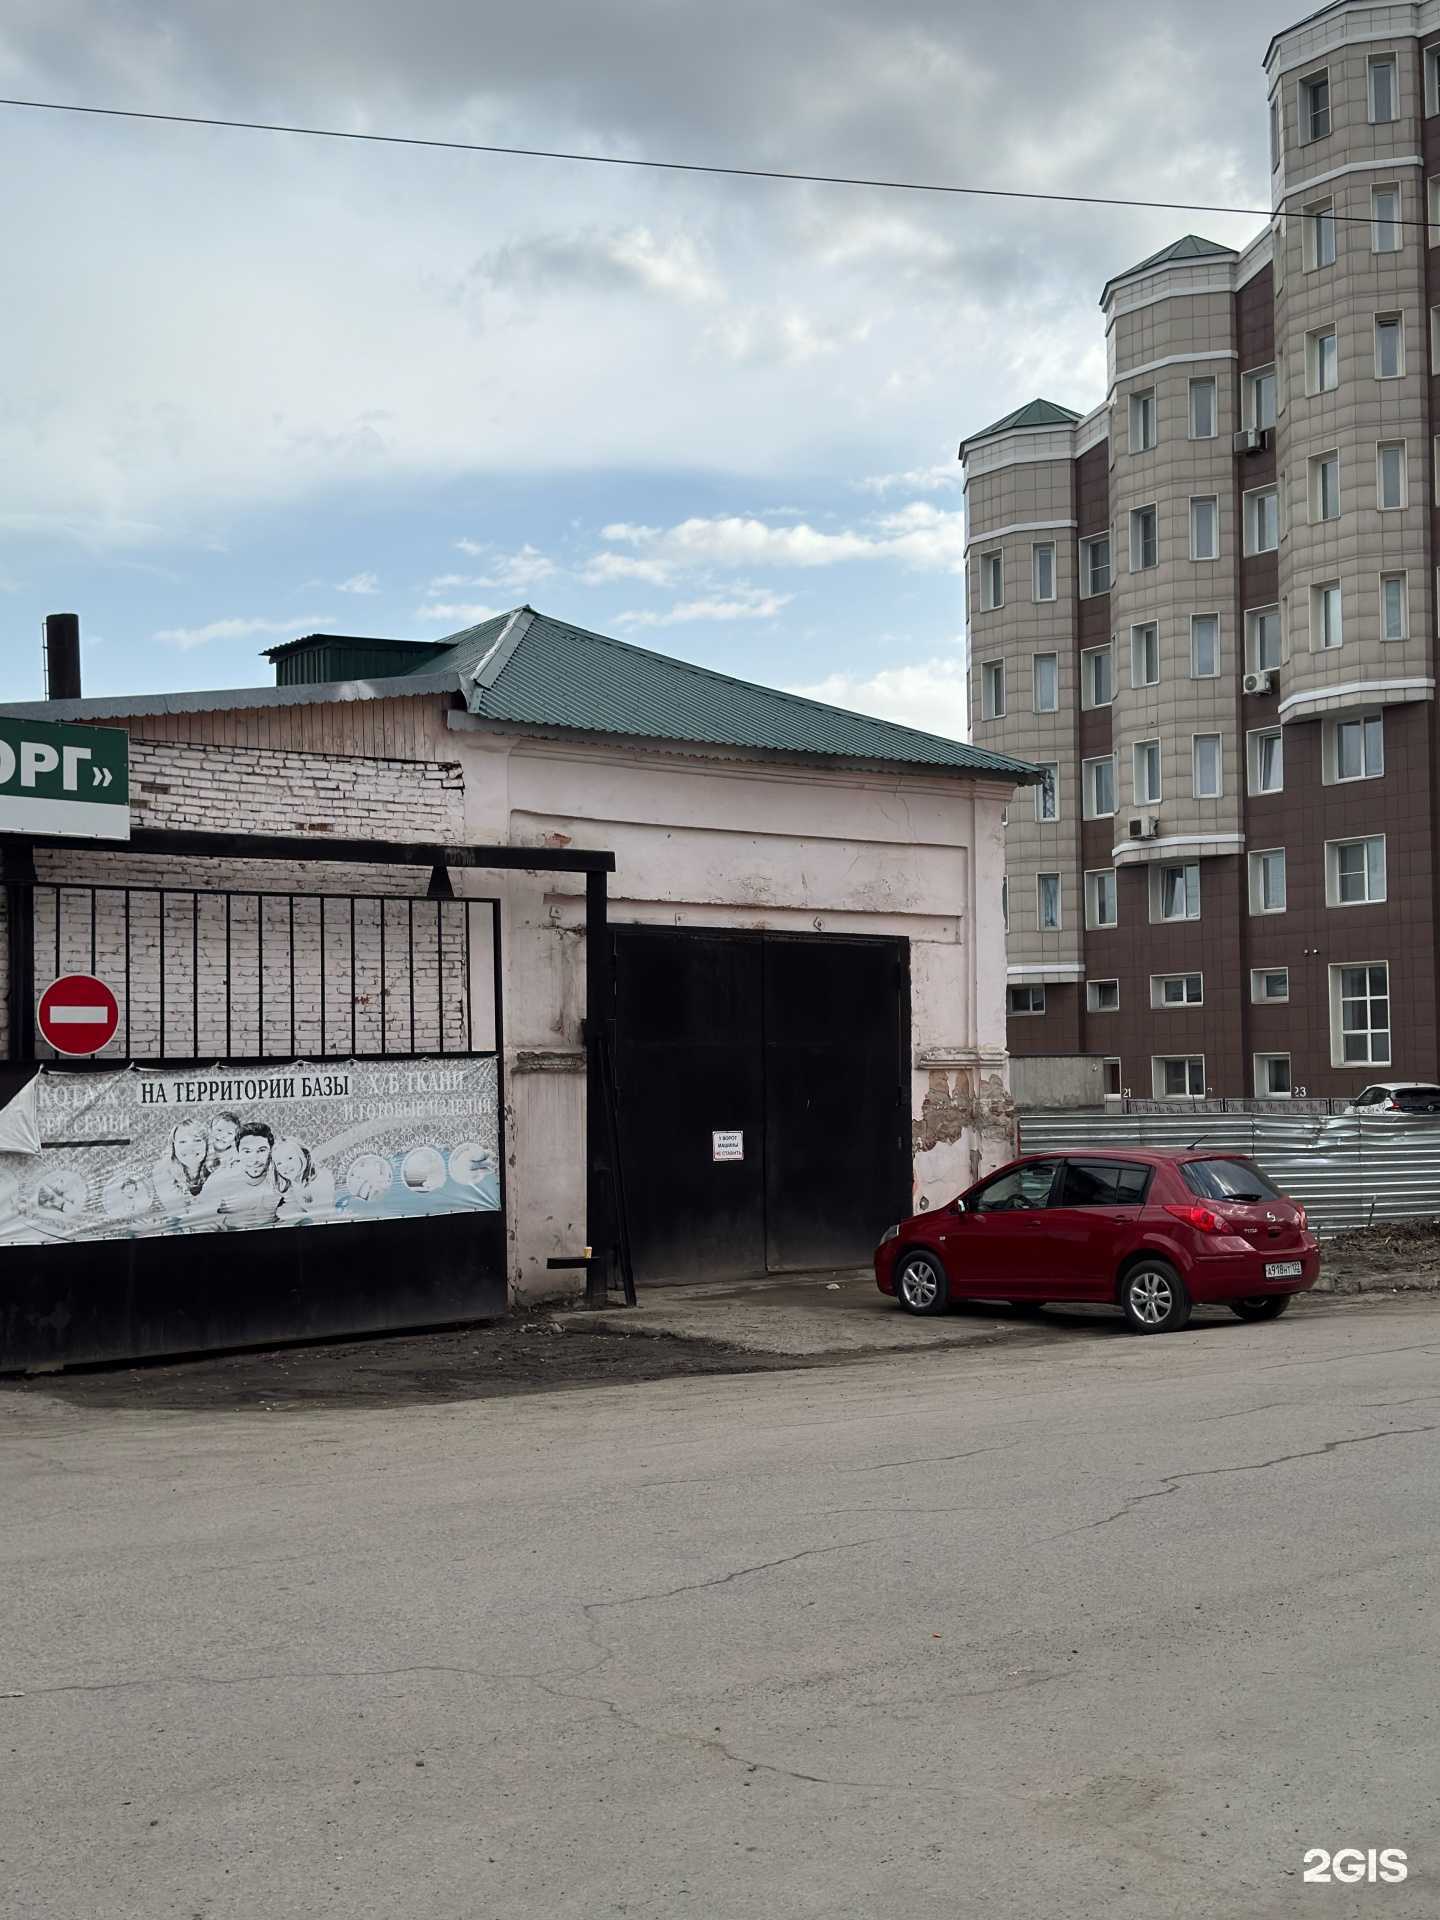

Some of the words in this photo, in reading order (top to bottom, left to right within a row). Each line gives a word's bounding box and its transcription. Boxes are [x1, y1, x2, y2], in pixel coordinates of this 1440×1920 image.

[141, 1083, 168, 1104] НА
[173, 1078, 295, 1102] ТЕРРИТОРИИ
[302, 1075, 350, 1097] БАЗЫ
[407, 1070, 465, 1093] ТКАНИ
[1123, 1087, 1132, 1098] 21
